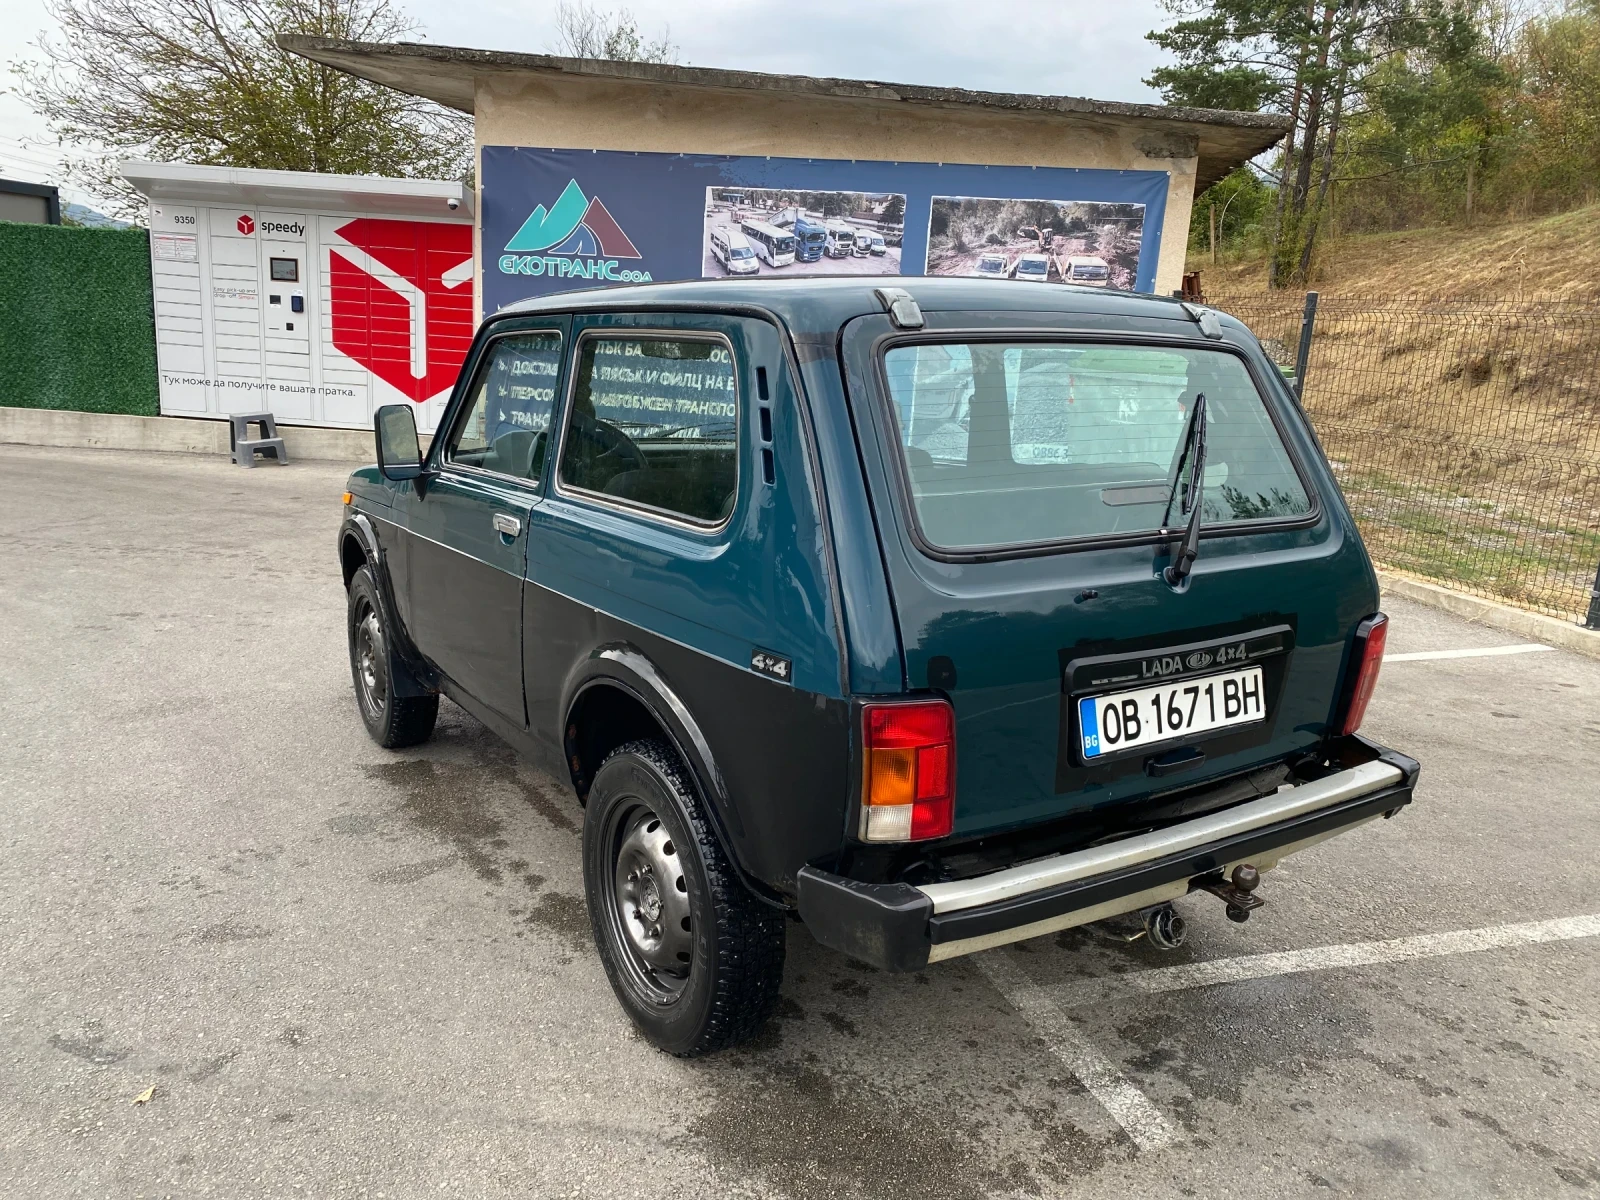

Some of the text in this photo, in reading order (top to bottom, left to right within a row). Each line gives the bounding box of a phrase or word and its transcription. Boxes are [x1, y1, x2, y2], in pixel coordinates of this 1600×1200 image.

[174, 215, 195, 225] 9350
[261, 222, 305, 236] speedy
[162, 375, 356, 397] Тук може да получите вашата пратка.
[705, 374, 723, 391] НА
[751, 653, 788, 677] 4x4
[1142, 642, 1247, 678] LADA 4x4
[1151, 682, 1216, 734] 1671
[1084, 734, 1099, 749] BG
